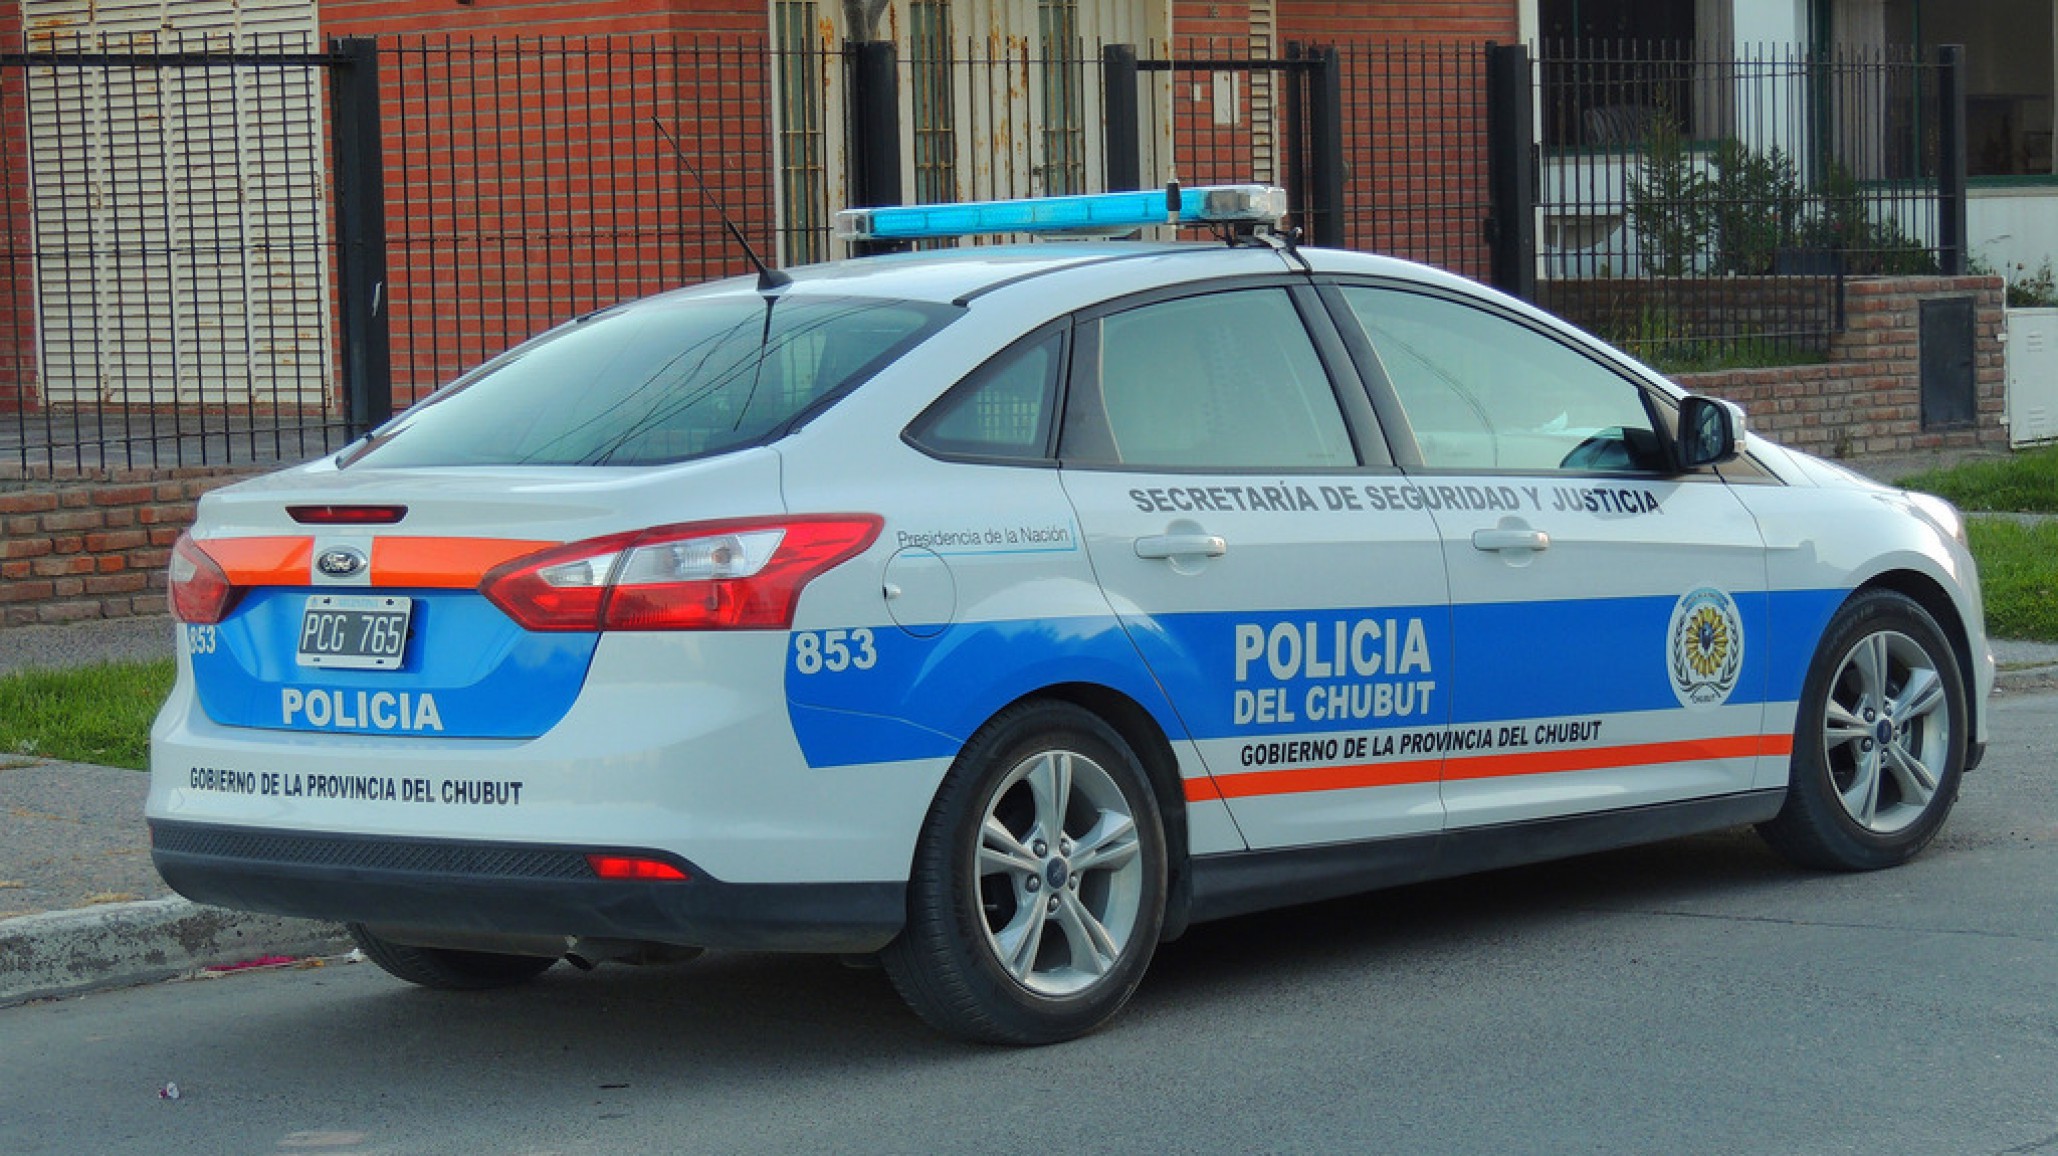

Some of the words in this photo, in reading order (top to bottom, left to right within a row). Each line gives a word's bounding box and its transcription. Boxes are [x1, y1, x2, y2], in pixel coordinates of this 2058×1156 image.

[1129, 480, 1319, 512] SECRETARÍA
[1319, 486, 1364, 511] DE
[1364, 485, 1520, 511] SEGURIDAD
[1521, 486, 1542, 511] Y
[1553, 487, 1664, 514] JUSTICIA
[897, 529, 981, 547] Presidencia
[984, 527, 1002, 544] de
[1005, 527, 1018, 543] la
[1020, 525, 1069, 543] Nación
[190, 625, 216, 654] 853
[302, 614, 347, 650] PCG
[359, 616, 403, 653] 765
[795, 628, 877, 674] 853
[1235, 618, 1432, 682] POLICIA
[281, 688, 444, 730] POLICIA
[1234, 688, 1295, 725] DEL
[1305, 681, 1436, 721] CHUBUT
[1241, 739, 1338, 766] GOBIERNO
[1343, 737, 1368, 759] DE
[1372, 735, 1394, 757] LA
[1399, 729, 1493, 755] PROVINCIA
[1498, 725, 1529, 747] DEL
[1535, 720, 1602, 744] CHUBUT
[190, 767, 256, 794] GOBIERNO
[260, 771, 280, 796] DE
[284, 773, 302, 797] LA
[307, 773, 397, 801] PROVINCIA
[401, 777, 436, 803] DEL
[441, 779, 523, 805] CHUBUT
